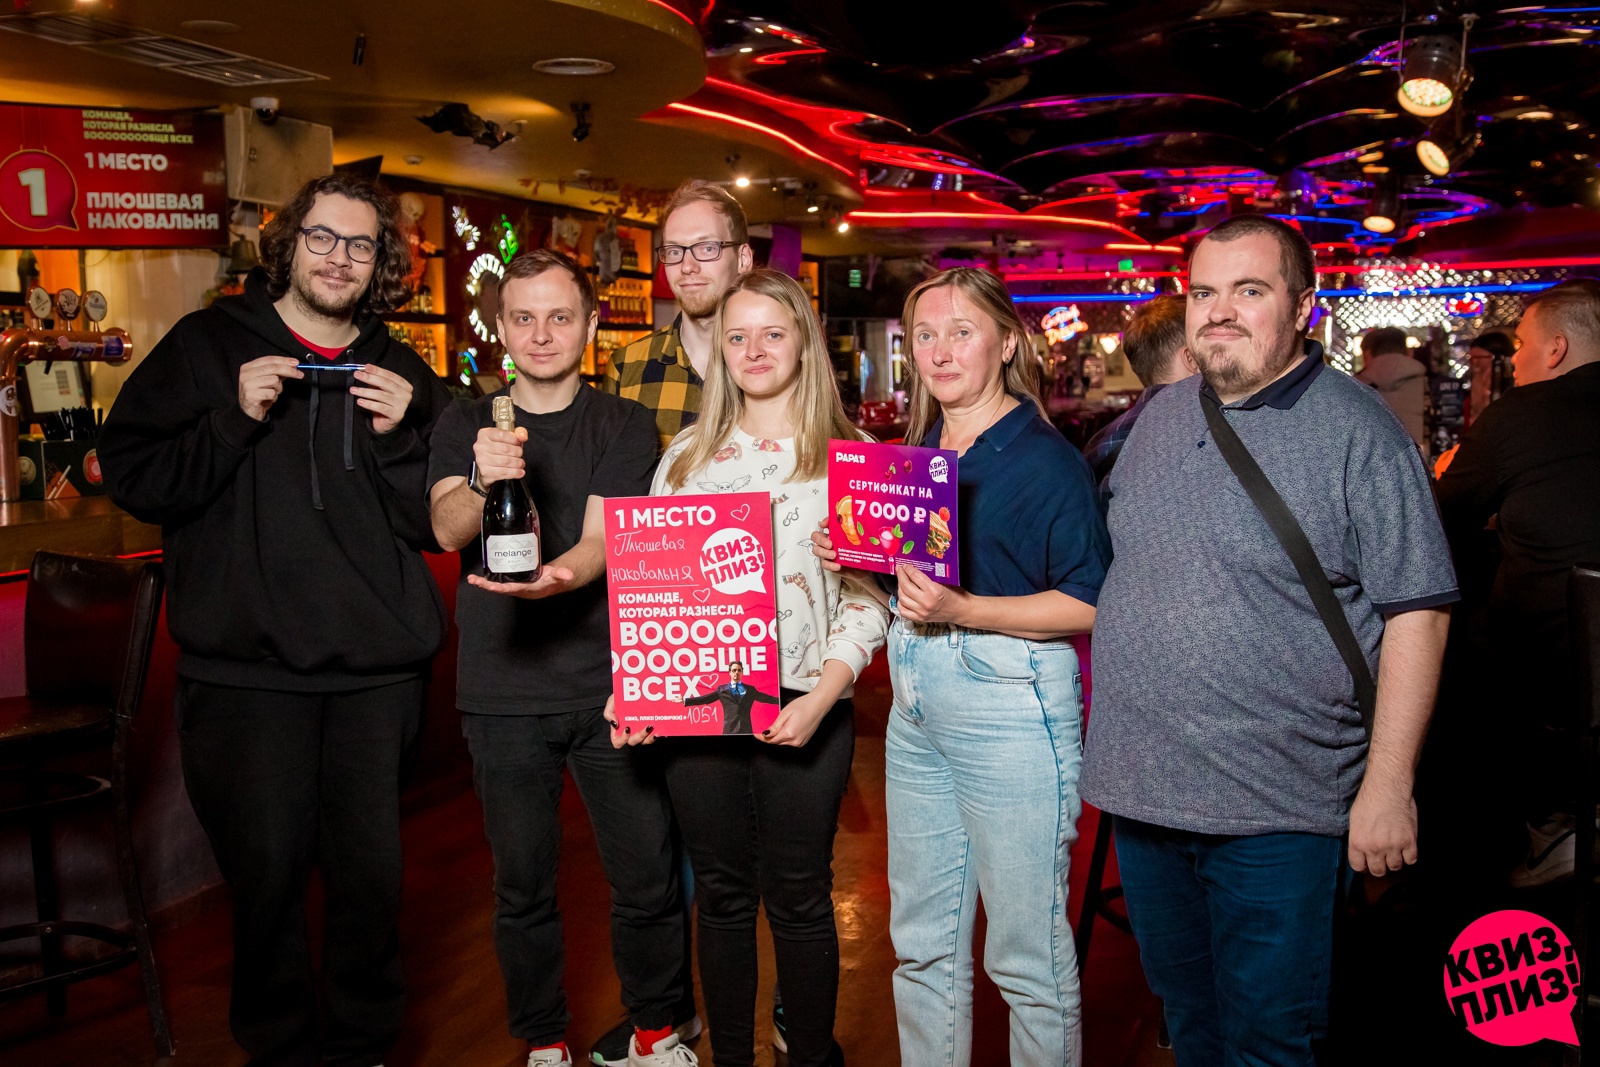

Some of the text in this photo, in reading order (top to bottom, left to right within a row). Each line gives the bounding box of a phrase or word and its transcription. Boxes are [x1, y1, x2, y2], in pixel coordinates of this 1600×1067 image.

[82, 110, 133, 121] КОМАНДА,
[83, 120, 175, 133] КОТОРАЯ РАЗНЕСЛА
[170, 134, 194, 144] ВСЕХ
[84, 152, 168, 172] 1 МЕСТО
[17, 168, 48, 217] 1
[86, 191, 204, 211] ПЛЮШЕВАЯ
[87, 212, 220, 230] НАКОВАЛЬНЯ
[849, 479, 933, 499] СЕРТИФИКАТ НА
[614, 505, 717, 529] 1 МЕСТО
[854, 499, 867, 516] 7
[869, 501, 911, 522] 000
[494, 549, 532, 557] melange
[614, 530, 686, 556] Плюшевая
[611, 560, 695, 583] наковальня
[617, 591, 684, 605] КОМАНДЕ,
[619, 604, 745, 619] КОТОРАЯ РАЗНЕСЛА
[622, 674, 701, 702] ВСЕХ
[687, 706, 718, 725] 1051
